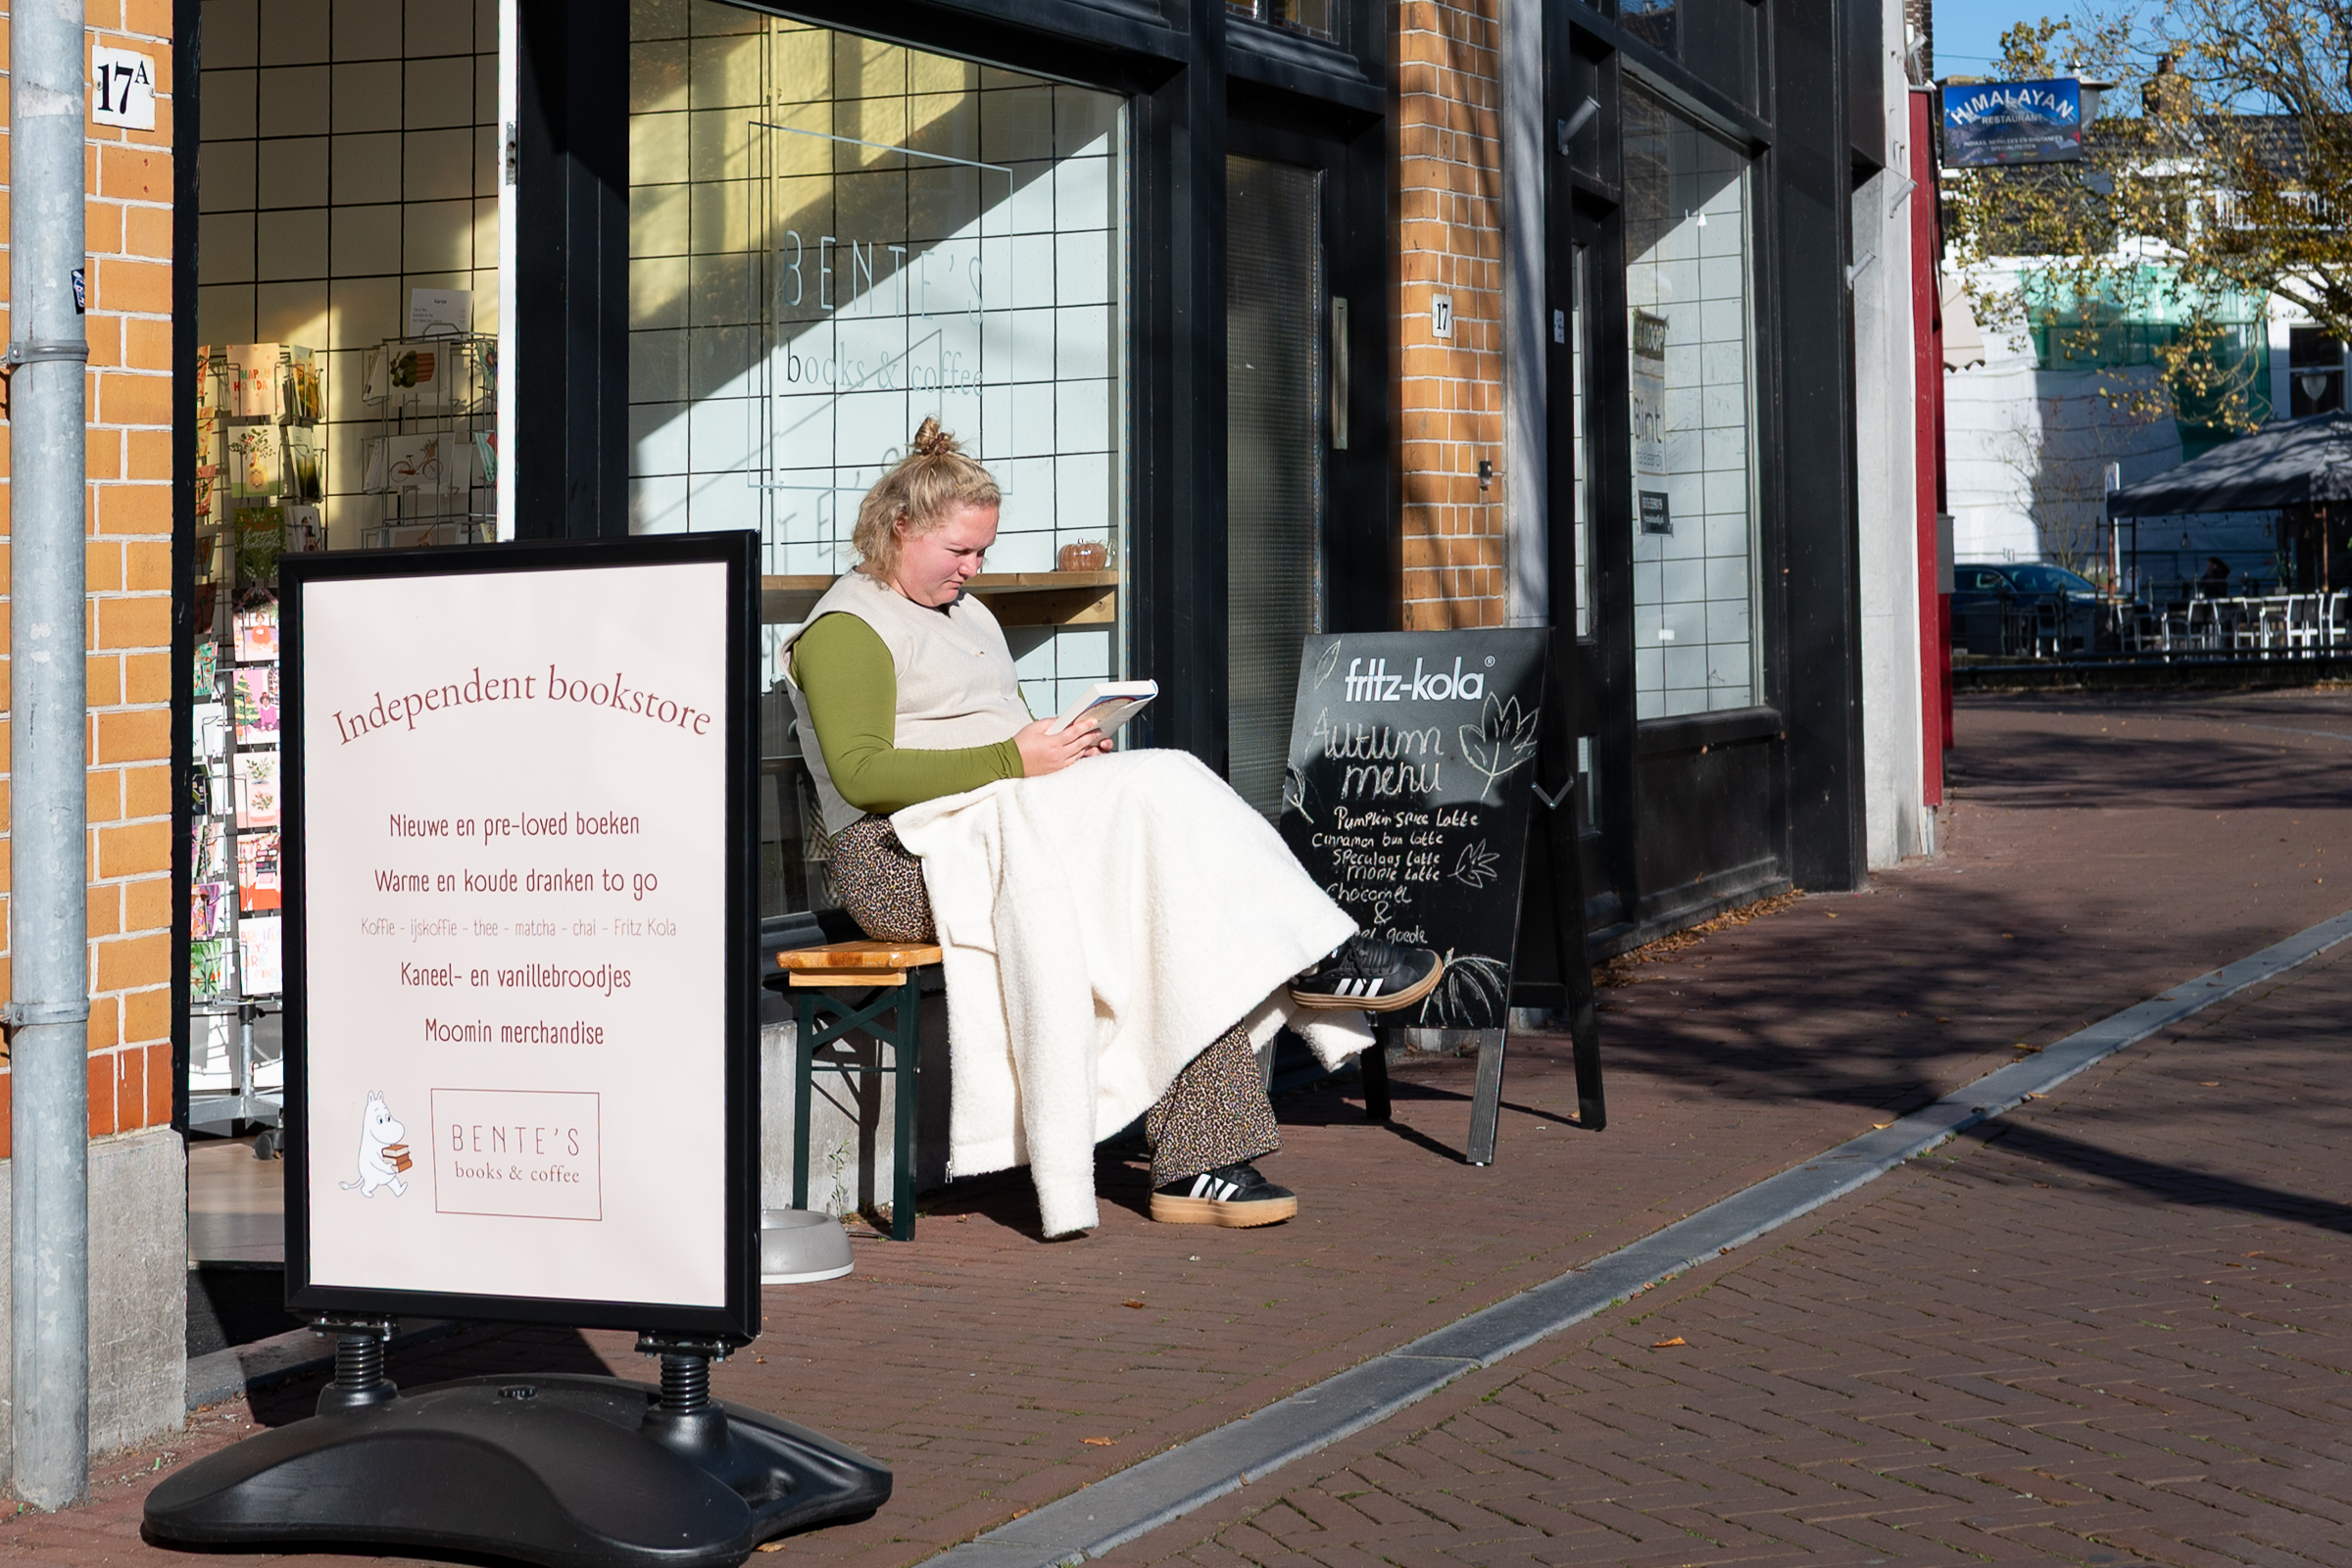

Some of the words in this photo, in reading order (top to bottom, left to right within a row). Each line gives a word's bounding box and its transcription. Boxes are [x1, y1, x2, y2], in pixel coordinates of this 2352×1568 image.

[97, 60, 150, 115] 17A
[1950, 88, 2074, 125] HIMALAYAN
[1982, 113, 2042, 124] RESTAURANT
[784, 229, 984, 326] BENTE'S
[1437, 300, 1448, 331] 17
[786, 335, 865, 389] books
[877, 350, 898, 391] &
[911, 349, 983, 397] coffee
[1345, 656, 1485, 702] fritz-kola
[332, 666, 536, 746] Independent
[547, 663, 711, 736] bookstore
[1341, 761, 1443, 801] menu
[390, 813, 449, 837] Nieuwe
[457, 817, 475, 836] en
[484, 811, 567, 846] pre-loved
[576, 810, 640, 835] boeken
[1382, 831, 1403, 847] bun
[374, 868, 430, 892] Warme
[437, 873, 456, 892] en
[465, 868, 518, 892] koude
[526, 867, 594, 892] dranken
[602, 868, 624, 891] to
[633, 872, 658, 901] go
[361, 916, 395, 936] Koffie
[411, 917, 458, 943] ijskoffie
[473, 918, 499, 936] thee
[514, 918, 556, 936] matcha
[572, 918, 596, 936] chai
[614, 917, 642, 936] Fritz
[648, 917, 676, 936] Kola
[1373, 900, 1393, 925] &
[401, 961, 463, 987] Kaneel-
[470, 967, 489, 987] en
[497, 963, 631, 997] vanillebroodjes
[425, 1017, 492, 1043] Moomin
[501, 1020, 604, 1045] merchandise
[452, 1124, 579, 1156] BENTE'S
[455, 1160, 503, 1180] books
[509, 1165, 523, 1181] &
[530, 1164, 580, 1184] coffee
